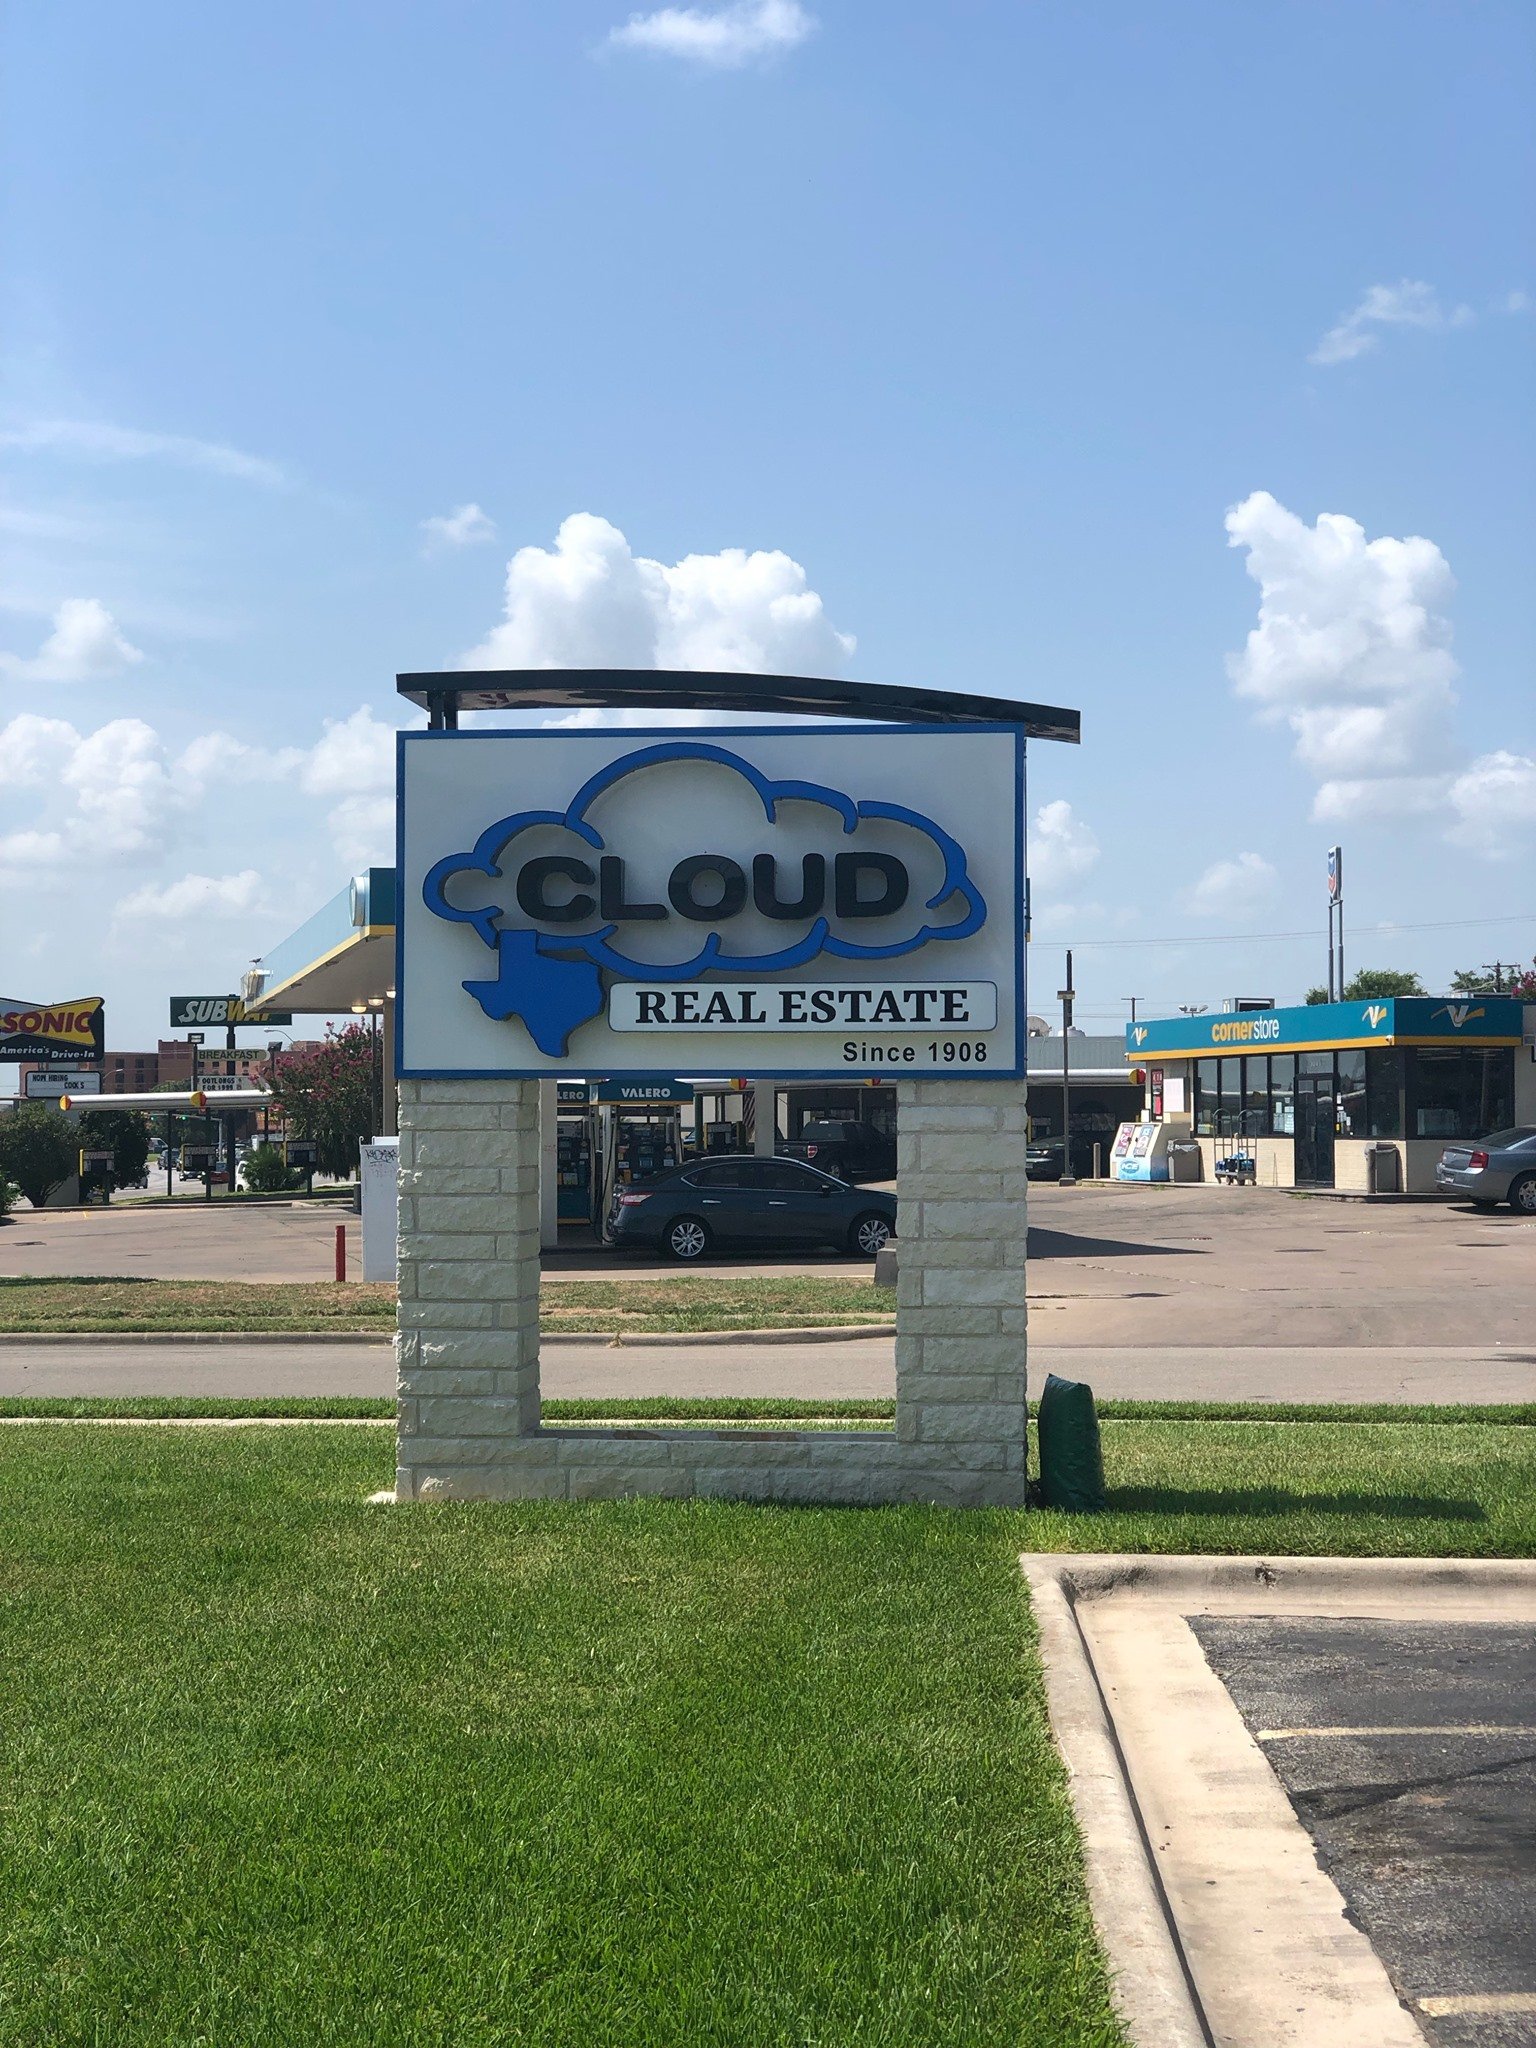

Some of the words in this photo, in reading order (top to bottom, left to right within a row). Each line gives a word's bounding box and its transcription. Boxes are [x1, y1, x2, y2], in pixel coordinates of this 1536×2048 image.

[516, 853, 909, 922] CLOUD
[635, 991, 766, 1024] REAL
[778, 990, 970, 1023] ESTATE
[1, 1011, 93, 1033] SONIC
[0, 1045, 49, 1054] America's
[51, 1050, 95, 1058] Drive-In
[199, 1051, 259, 1060] BREAKFAST
[842, 1042, 916, 1063] Since
[928, 1042, 988, 1063] 1908
[32, 1074, 47, 1082] NOW
[48, 1074, 69, 1082] HIRING
[556, 1091, 585, 1100] LERO
[621, 1087, 671, 1097] VALERO
[1121, 1163, 1139, 1171] ICE
